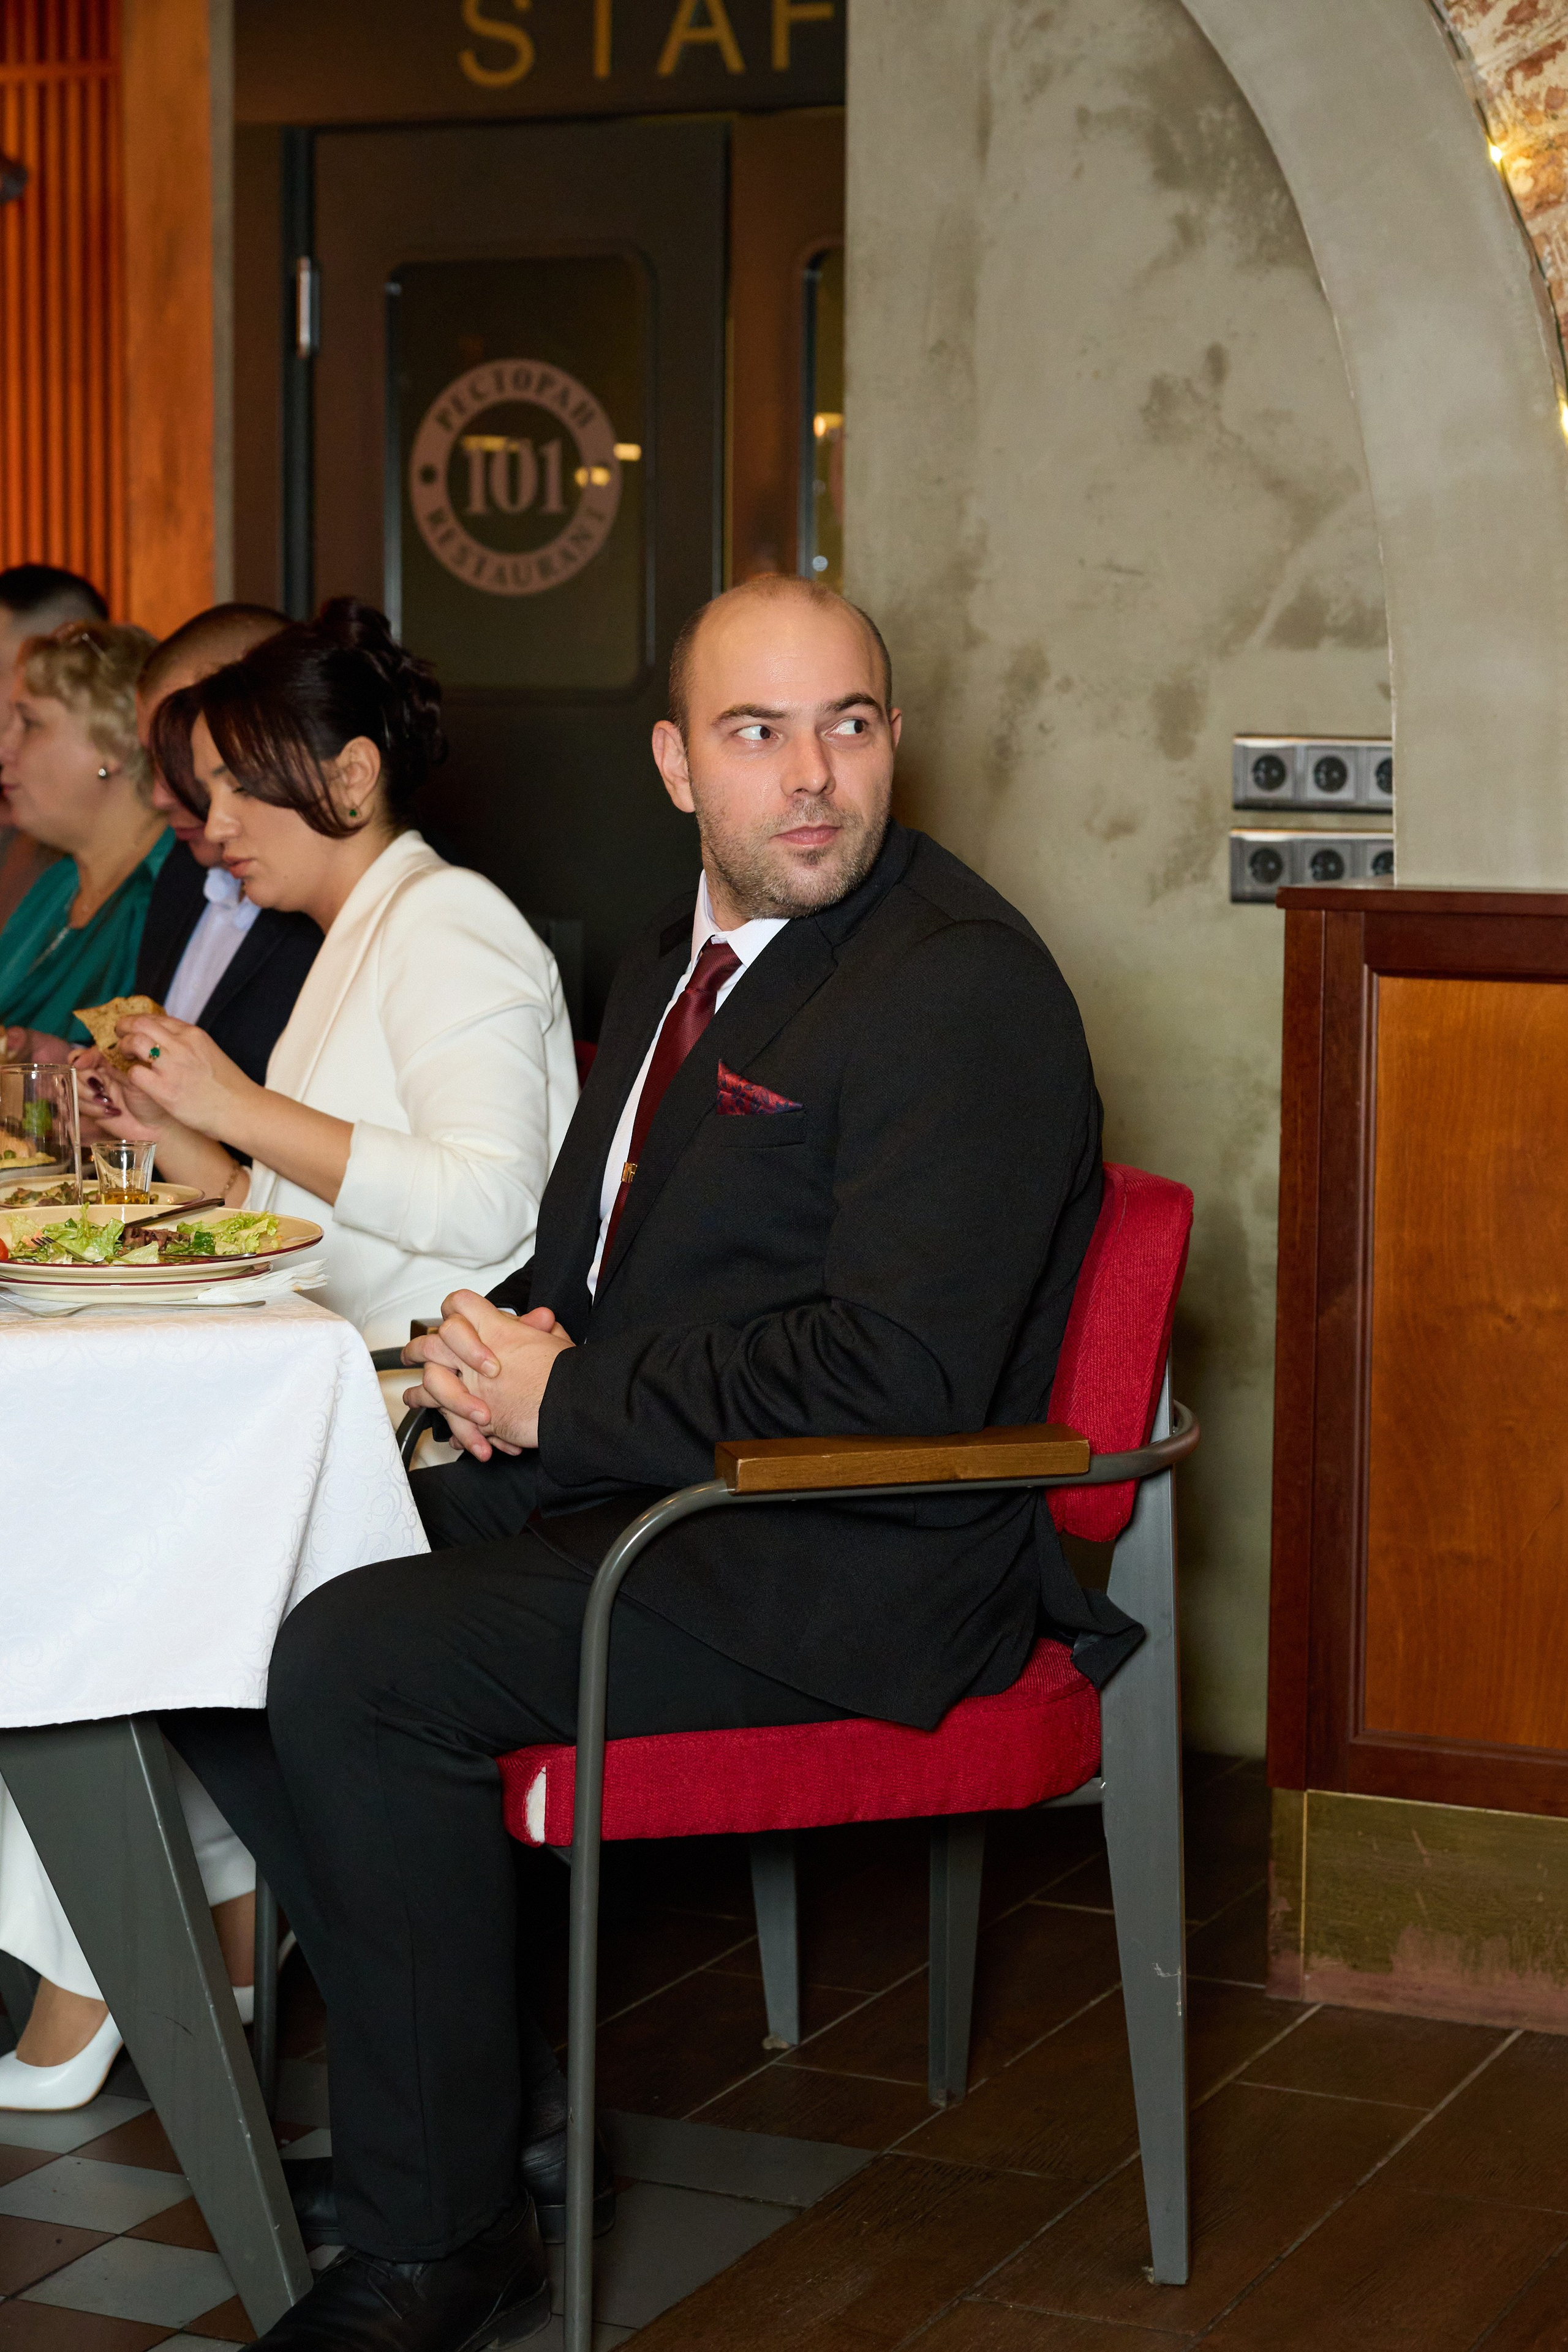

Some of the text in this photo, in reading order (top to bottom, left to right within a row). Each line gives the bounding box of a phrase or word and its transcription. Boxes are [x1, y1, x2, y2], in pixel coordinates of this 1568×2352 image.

[435, 368, 595, 431] РЕСТОРАН
[464, 437, 566, 516] 101
[428, 505, 606, 588] RESTAURANT
